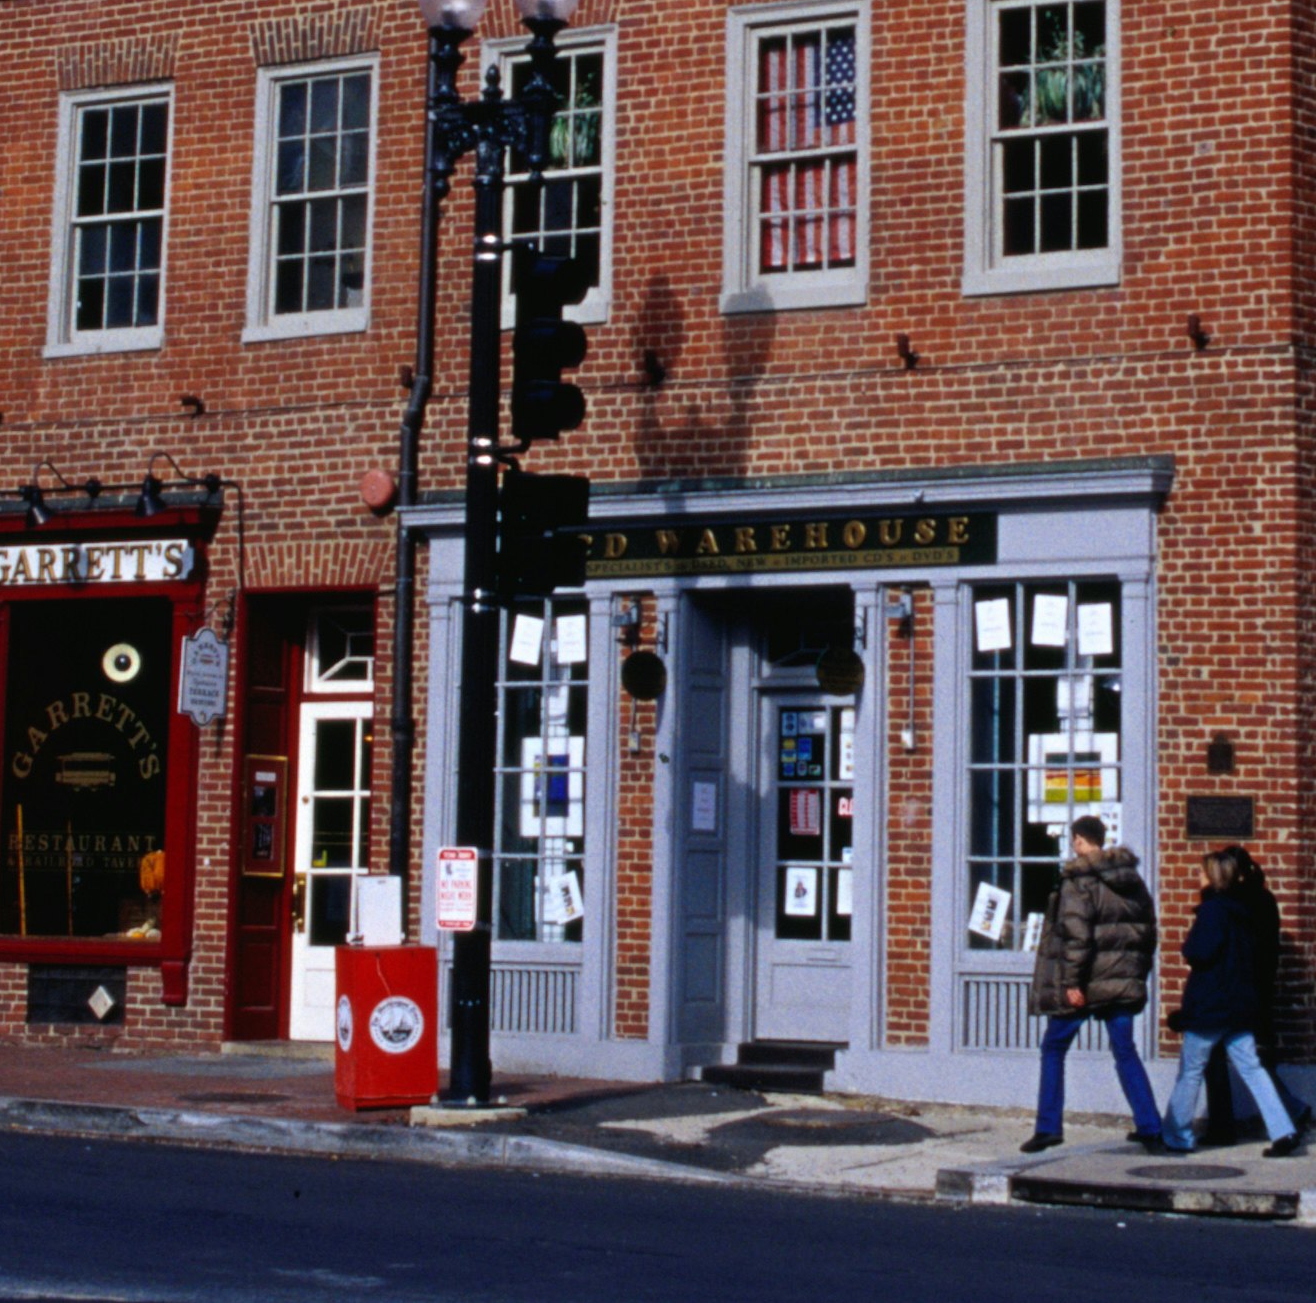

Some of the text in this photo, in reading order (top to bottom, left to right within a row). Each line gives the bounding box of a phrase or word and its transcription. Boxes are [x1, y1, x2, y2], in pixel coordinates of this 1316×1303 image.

[654, 516, 970, 555] WAREHOUSE
[737, 557, 766, 568] NEW
[785, 553, 858, 566] IMPORTED
[912, 548, 955, 562] DVD'S
[12, 692, 160, 780] GARRETT'S
[8, 834, 156, 853] RESTAURANT
